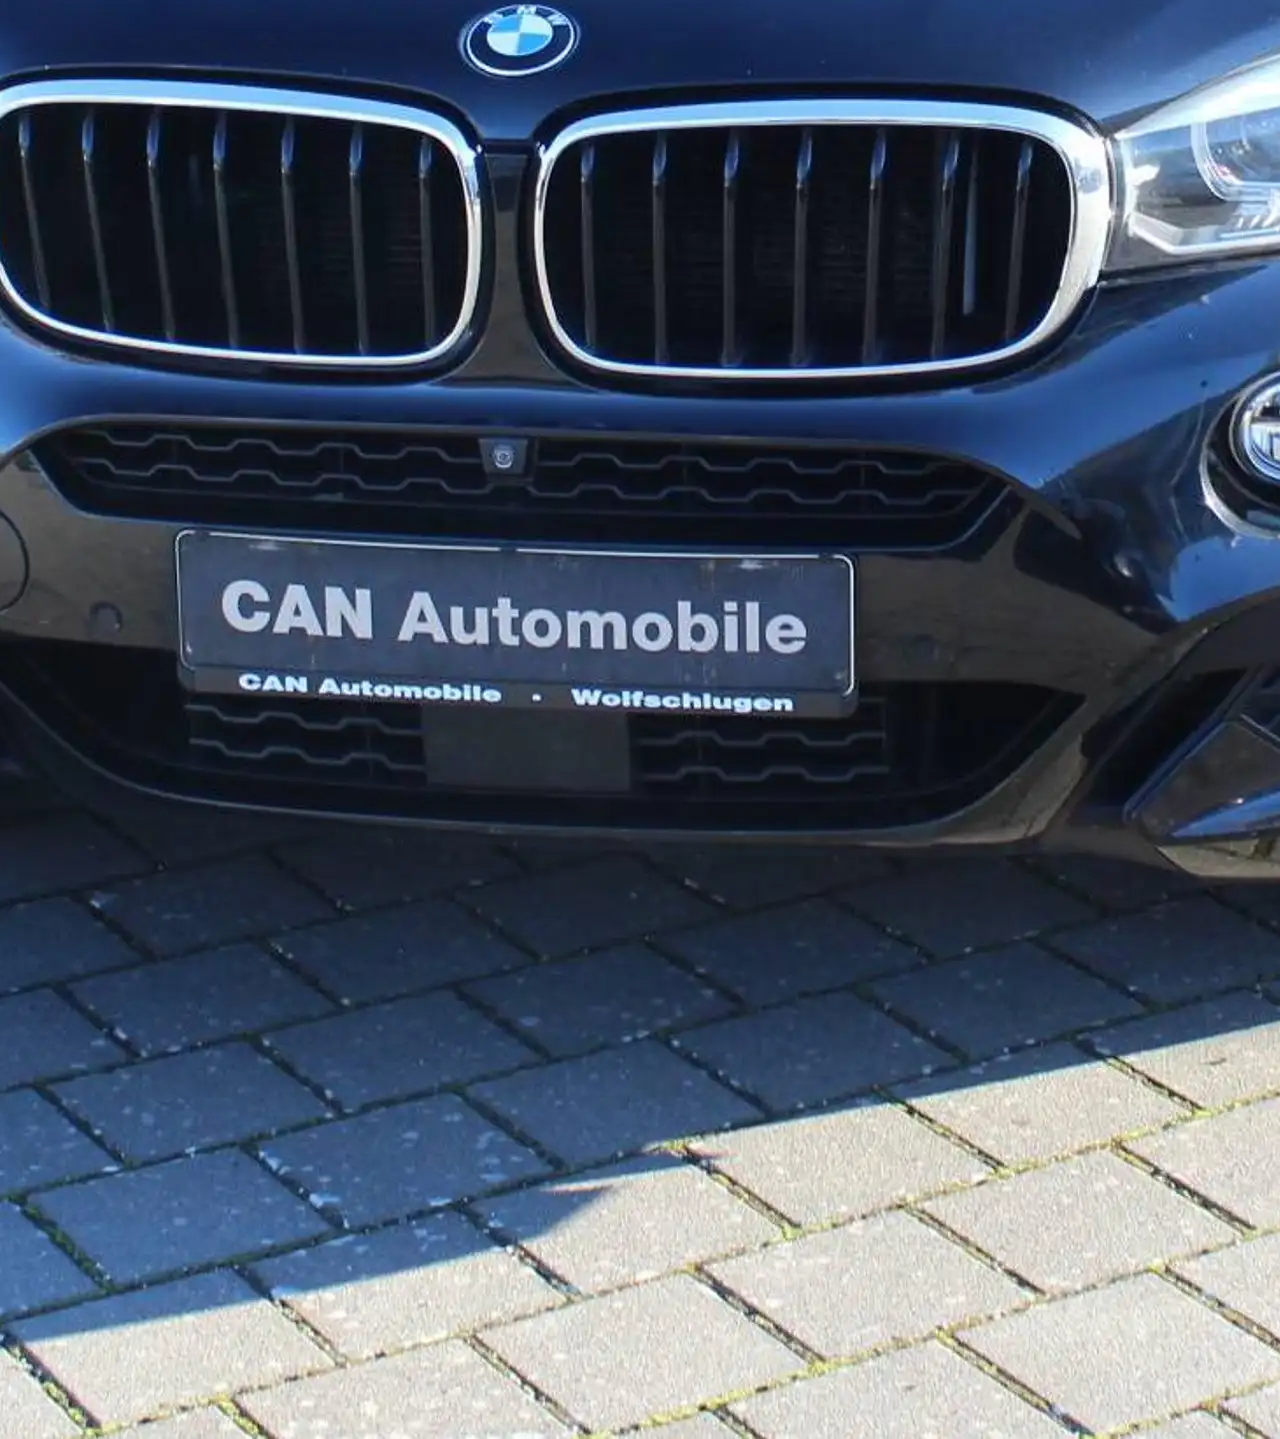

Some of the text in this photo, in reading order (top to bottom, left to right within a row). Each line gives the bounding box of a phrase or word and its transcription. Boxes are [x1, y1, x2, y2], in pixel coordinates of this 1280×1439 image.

[221, 579, 807, 654] CAN Automobile
[238, 673, 794, 713] CAN Automobile Wolfschlugen
